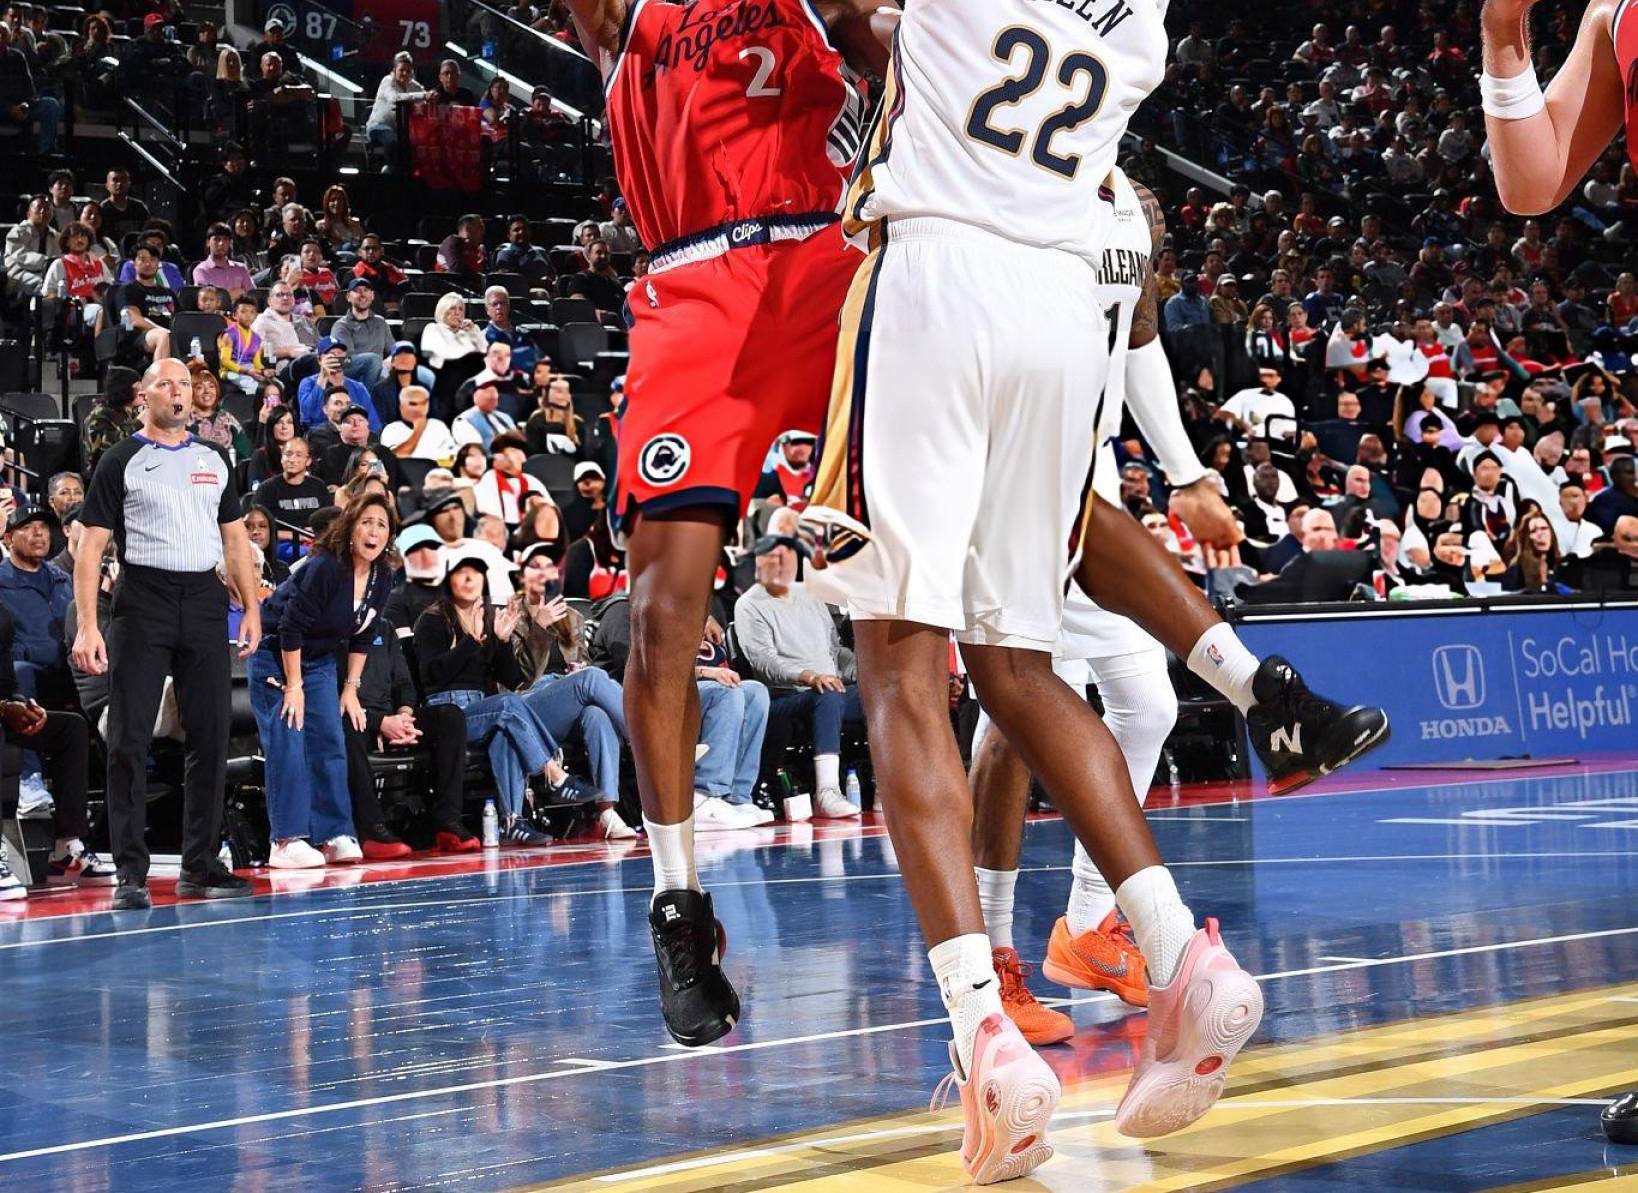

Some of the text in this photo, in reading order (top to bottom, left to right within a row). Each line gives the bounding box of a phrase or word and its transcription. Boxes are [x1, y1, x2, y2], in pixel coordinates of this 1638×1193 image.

[305, 11, 338, 42] 87
[399, 19, 432, 49] 73
[644, 0, 782, 88] Angeles
[738, 45, 781, 98] 2
[963, 24, 1111, 182] 22
[732, 222, 764, 243] Clips
[1097, 248, 1148, 287] RLEAN
[1521, 634, 1601, 678] SoCal
[1419, 715, 1513, 740] HONDA
